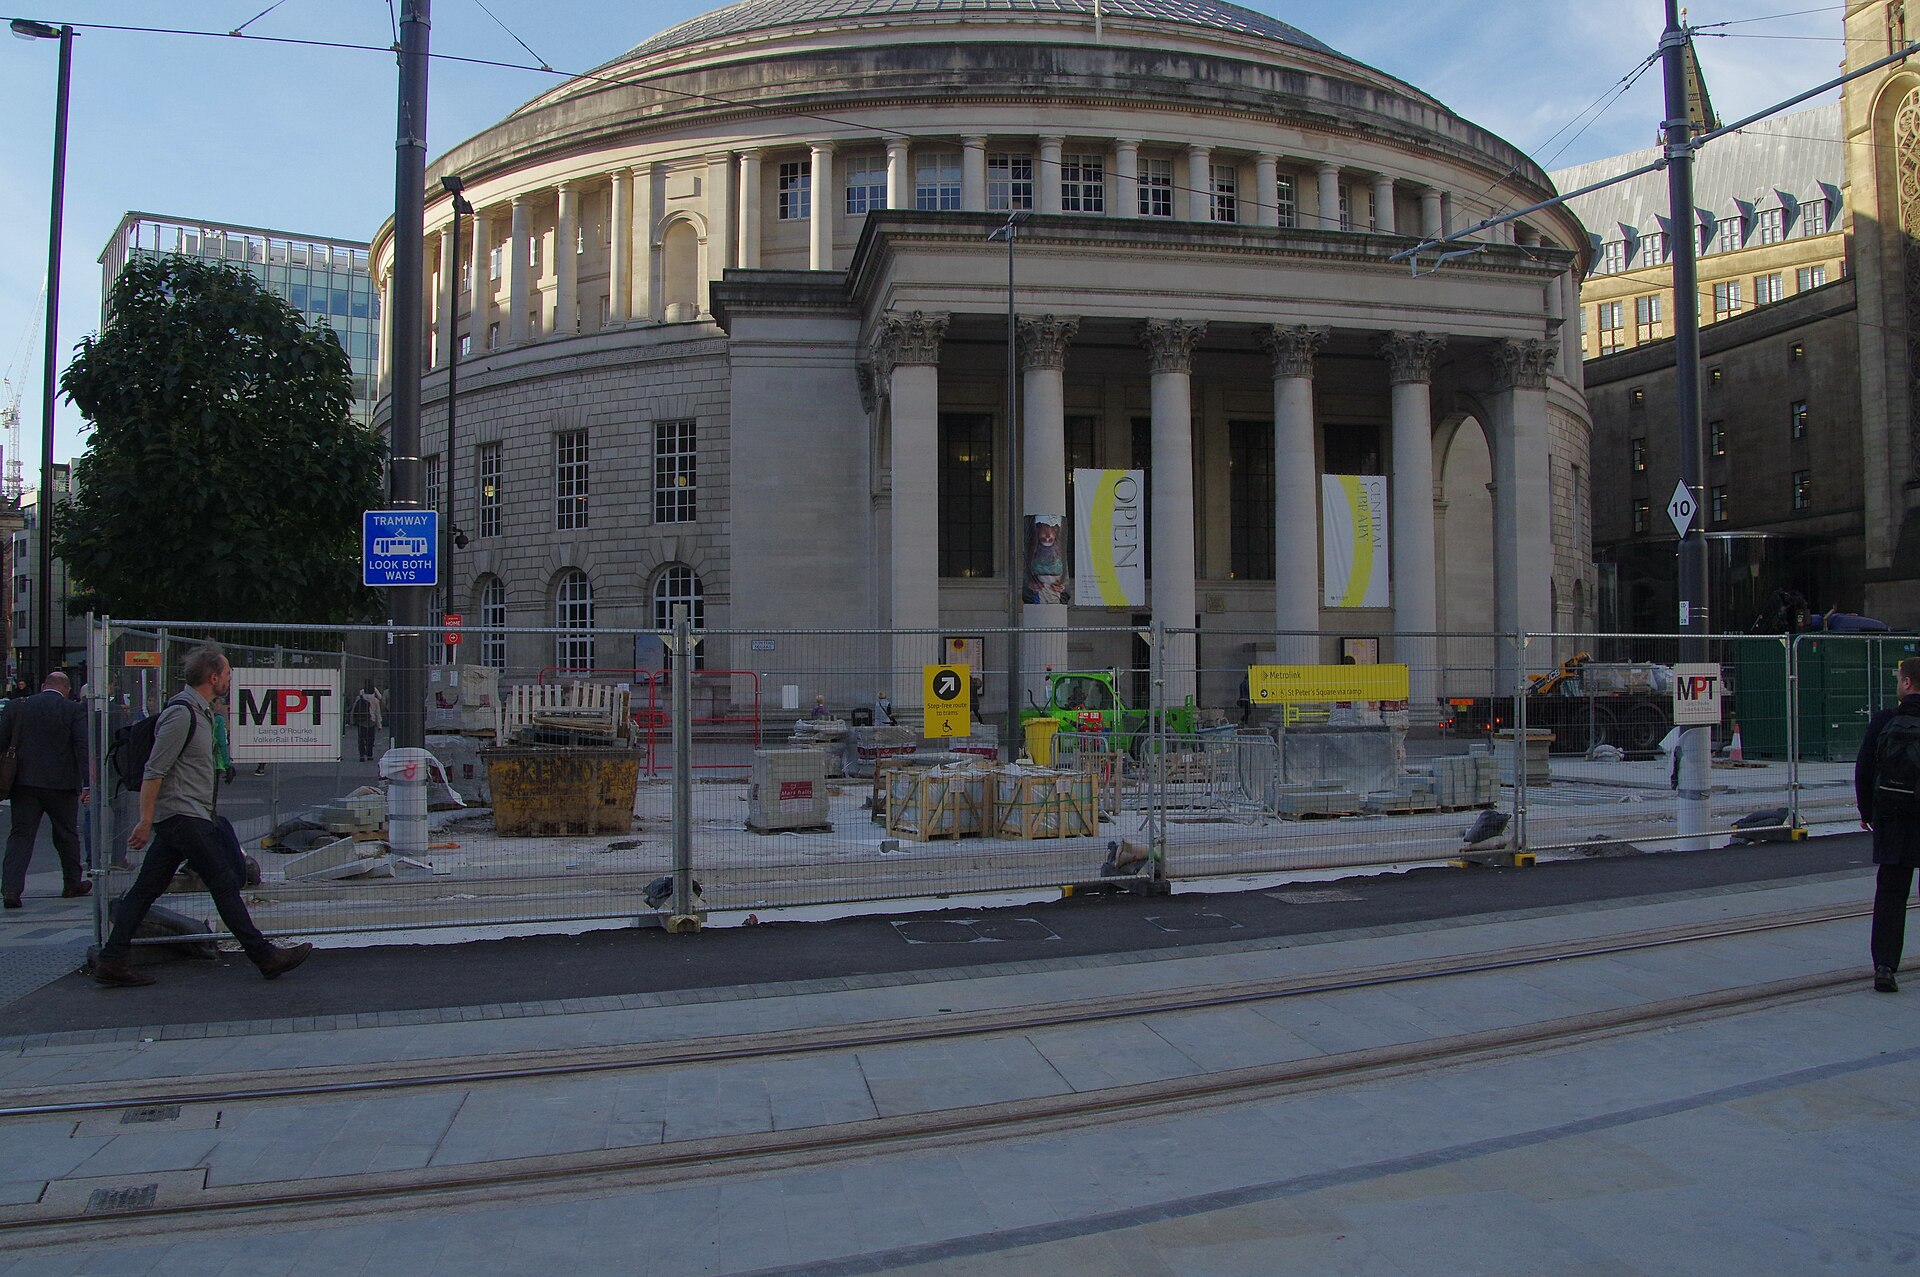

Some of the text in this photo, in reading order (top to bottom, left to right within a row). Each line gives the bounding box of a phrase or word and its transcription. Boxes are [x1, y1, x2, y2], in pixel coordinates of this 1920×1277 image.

[1357, 483, 1370, 542] LIBRARY
[1673, 500, 1690, 517] 10
[373, 516, 428, 526] TRAMWAY
[1113, 476, 1138, 569] OPEN
[1370, 481, 1383, 553] CENTRAL
[369, 560, 432, 570] LOOK BOTH
[385, 571, 416, 580] WAYS
[1269, 671, 1301, 680] Metrolink
[1295, 688, 1315, 697] Peter's
[1316, 688, 1337, 697] Square
[1677, 676, 1717, 701] MPT
[238, 689, 332, 726] MPT
[258, 727, 313, 736] Laing O'Rourke
